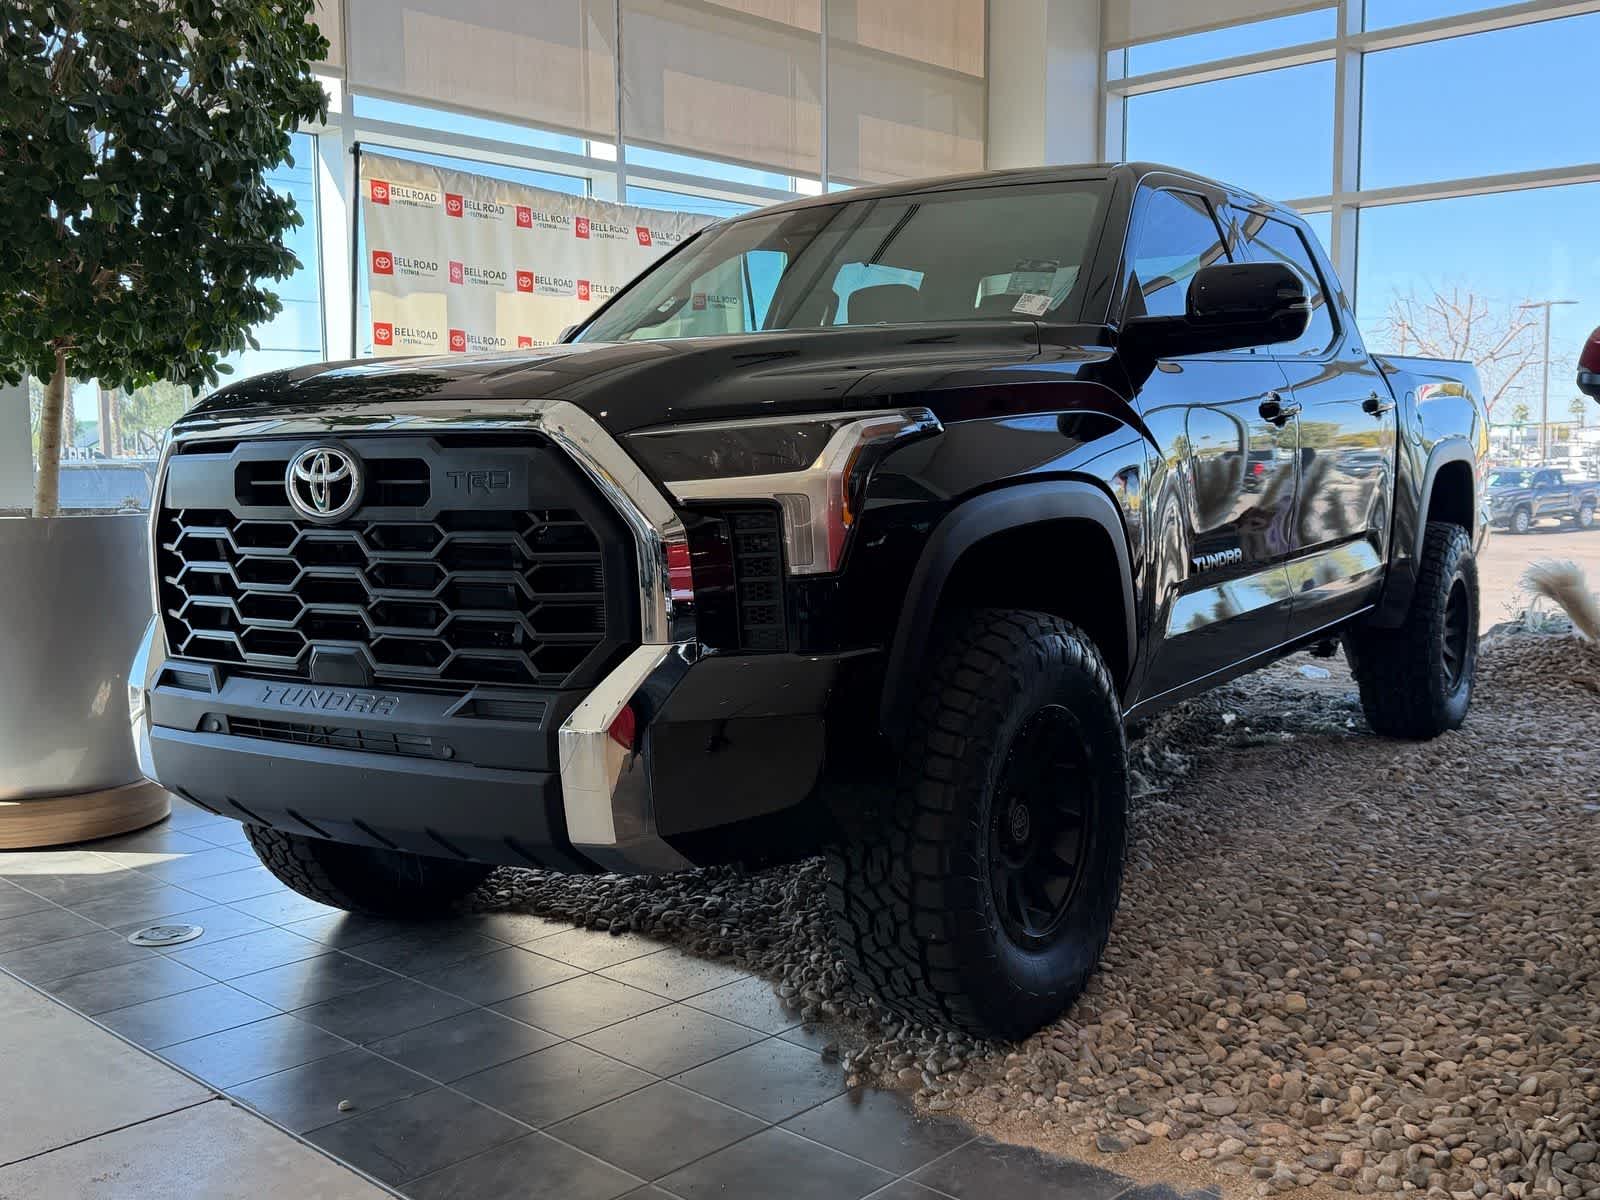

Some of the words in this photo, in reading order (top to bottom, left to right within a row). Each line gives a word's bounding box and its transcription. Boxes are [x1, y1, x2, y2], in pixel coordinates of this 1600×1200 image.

[391, 186, 411, 198] BELL
[412, 191, 437, 202] ROAD
[464, 199, 482, 211] BELL
[483, 203, 505, 215] ROAD
[532, 211, 549, 222] BELL
[590, 222, 608, 232] BELL
[393, 256, 413, 268] BELL
[414, 259, 438, 271] ROAD
[464, 266, 482, 277] BELL
[483, 269, 507, 280] ROAD
[535, 275, 552, 286] BELL
[553, 278, 573, 288] ROAD
[394, 327, 416, 337] BELL
[416, 329, 438, 340] ROAD
[466, 335, 482, 345] BELL
[482, 336, 507, 346] ROAD
[447, 471, 511, 496] TRD
[1192, 548, 1242, 572] TUNDRA
[261, 685, 400, 715] TUNDRA
